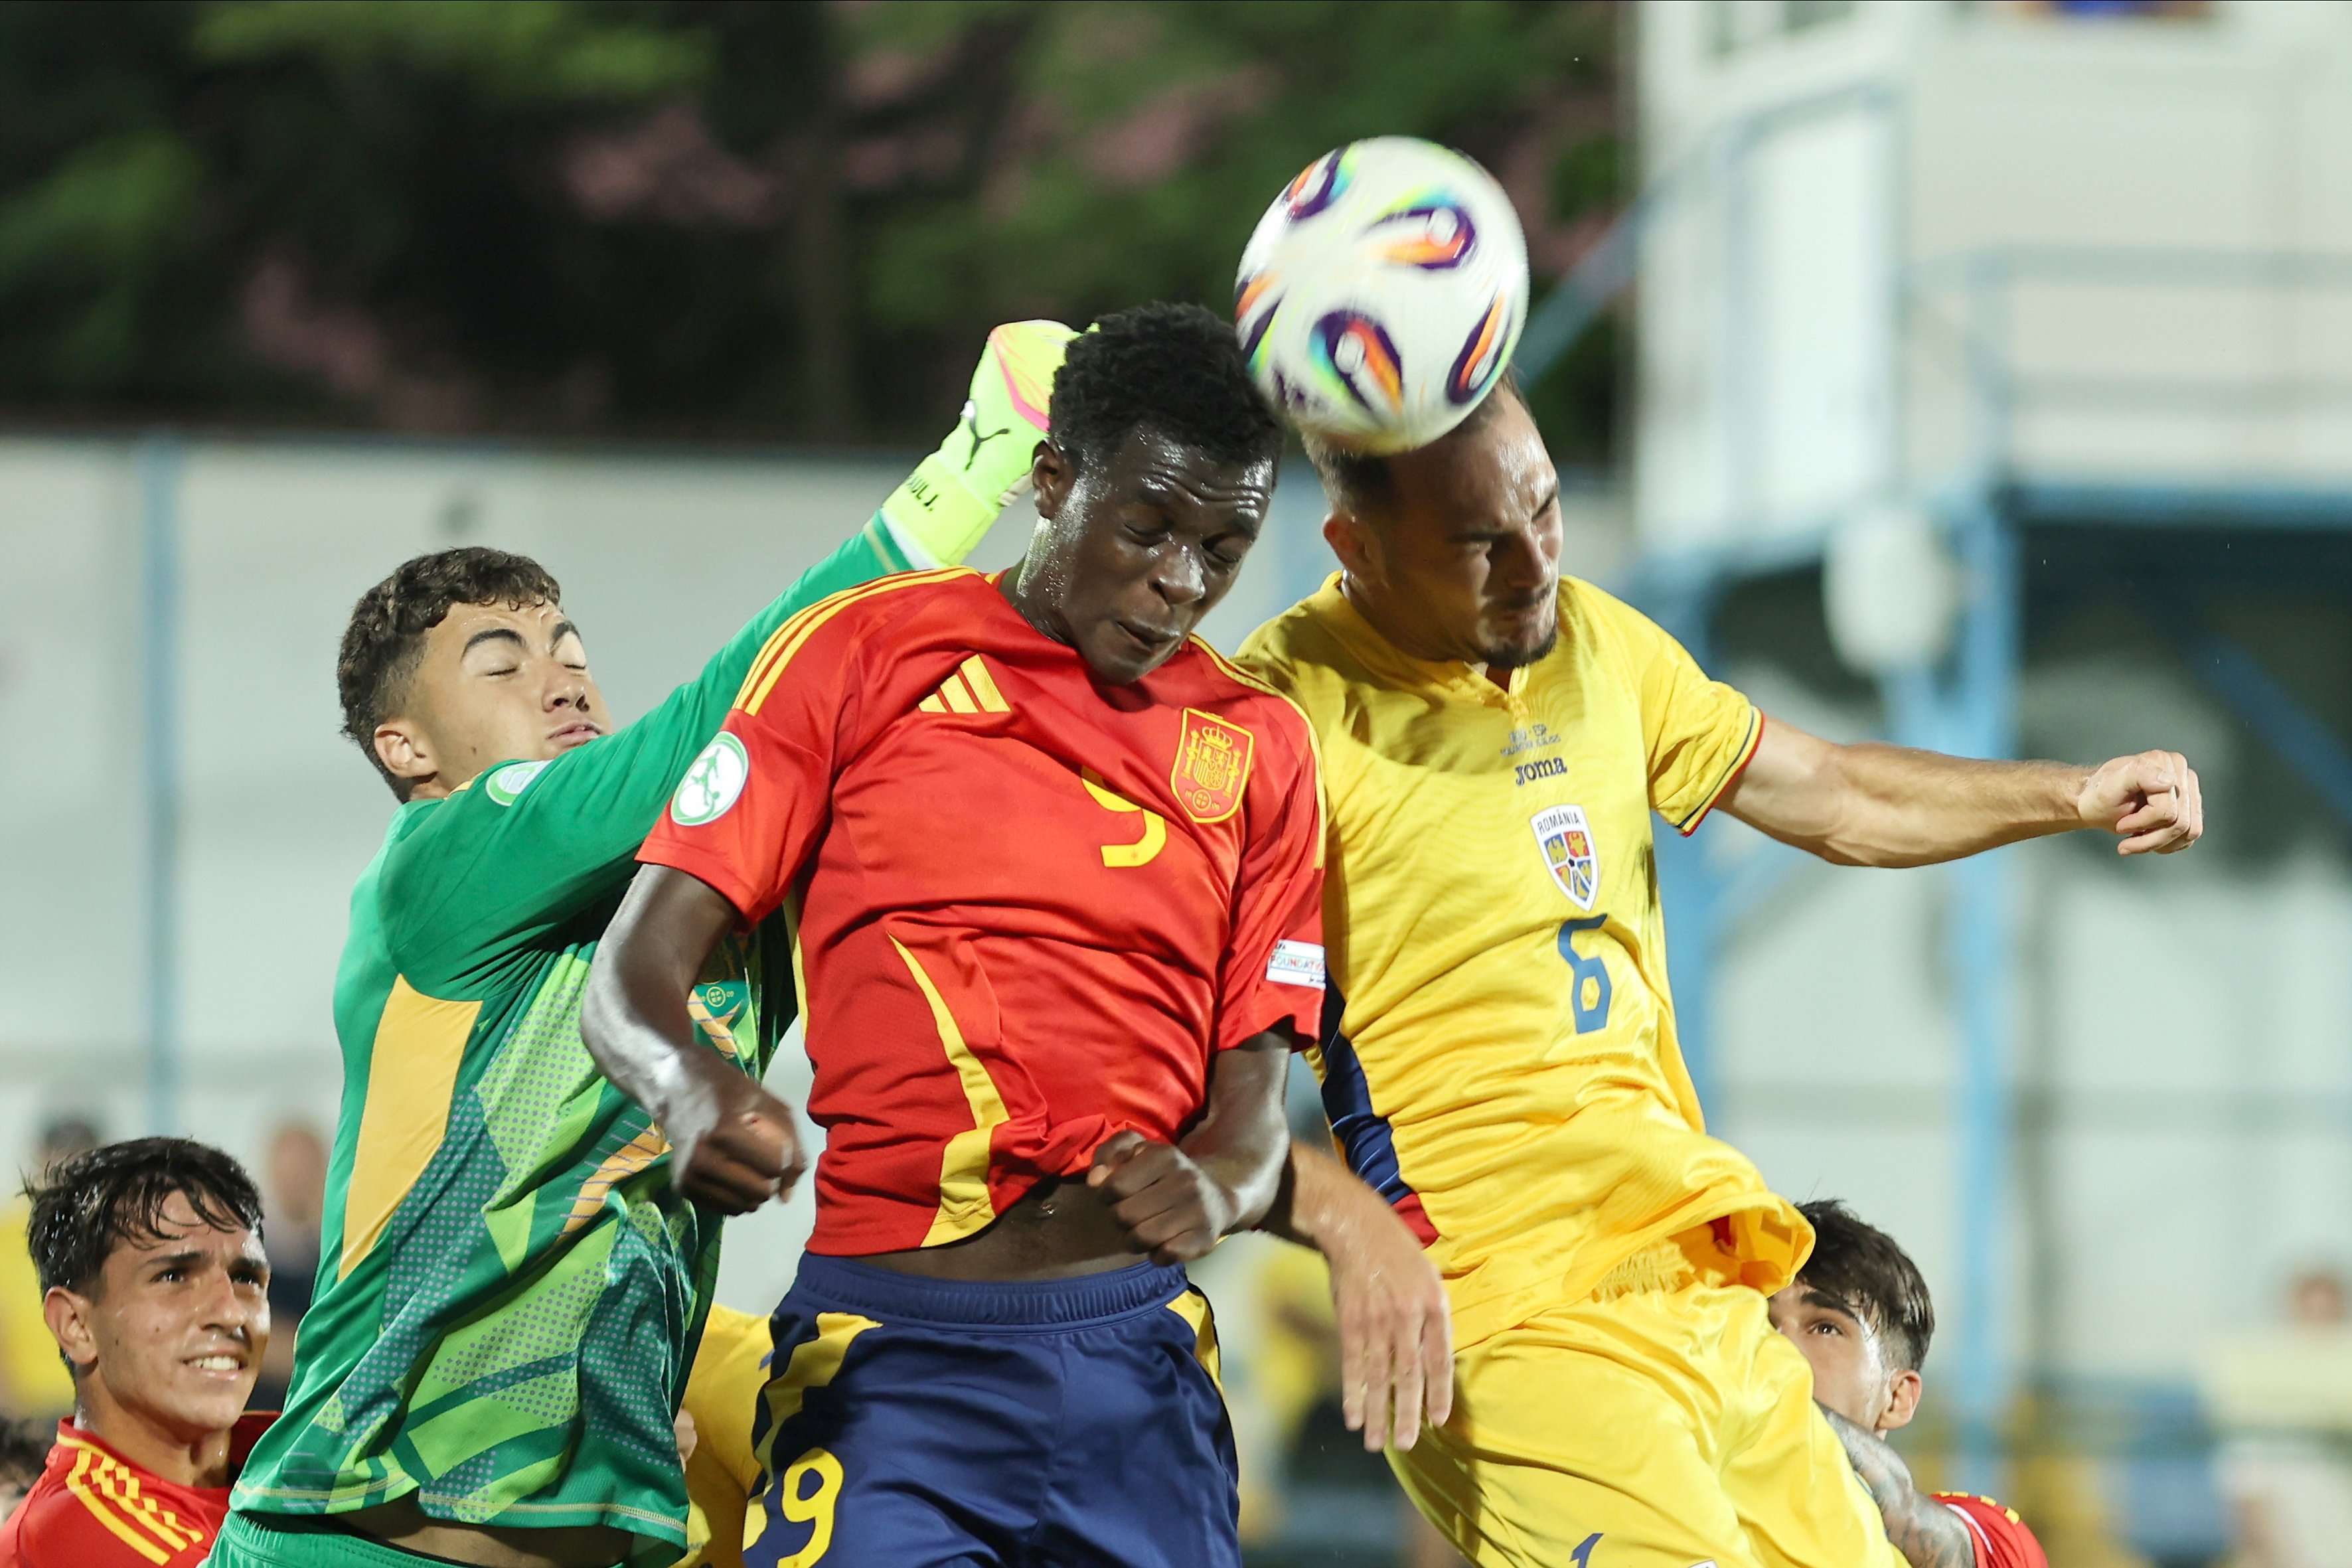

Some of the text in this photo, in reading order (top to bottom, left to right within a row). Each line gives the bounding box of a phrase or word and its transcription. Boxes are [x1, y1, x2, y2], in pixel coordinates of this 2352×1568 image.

[1270, 955, 1324, 972] FOUNDATIO
[1557, 913, 1612, 1035] 6
[776, 1447, 844, 1568] 9
